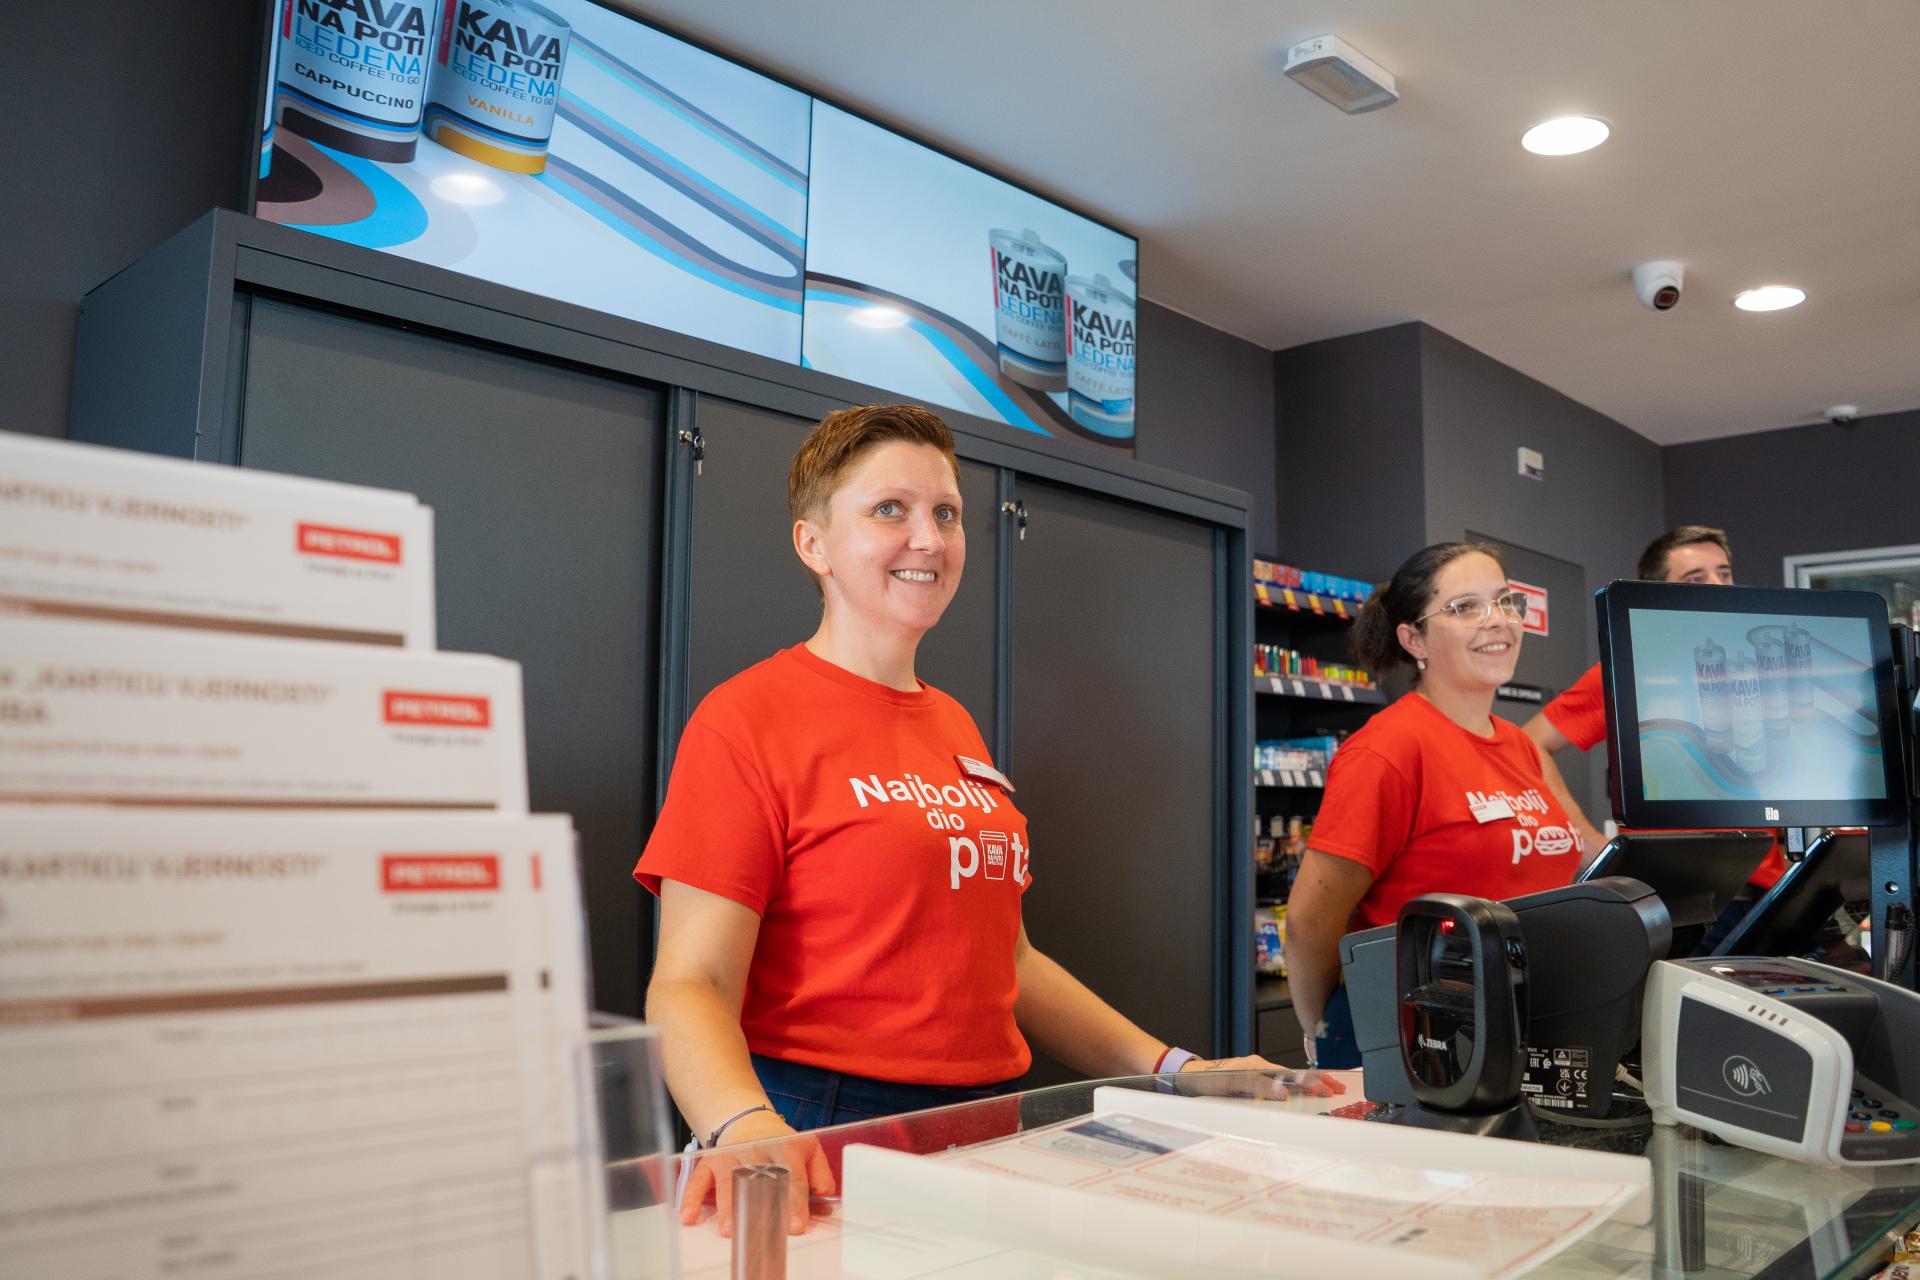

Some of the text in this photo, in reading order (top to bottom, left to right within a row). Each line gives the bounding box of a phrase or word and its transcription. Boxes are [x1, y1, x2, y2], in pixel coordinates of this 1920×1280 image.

[297, 0, 346, 34] NA
[354, 21, 424, 55] POTI
[458, 1, 561, 63] KAVA
[296, 16, 421, 75] LEDENA
[456, 28, 496, 62] NA
[503, 50, 559, 80] POTI
[328, 53, 385, 79] COFFEE
[390, 72, 405, 83] TO
[454, 47, 555, 97] LEDENA
[294, 63, 414, 109] CAPPUCCINO
[480, 78, 527, 102] COFFEE
[467, 95, 534, 125] VANILLA
[997, 251, 1062, 295] KAVA
[999, 275, 1021, 300] NA
[1073, 299, 1134, 341] KAVA
[1074, 323, 1096, 348] NA
[1732, 679, 1760, 696] KAVA
[849, 773, 998, 813] Najbolji
[927, 808, 965, 831] dio
[1517, 813, 1539, 827] dio
[1426, 1039, 1447, 1051] ZEBRA
